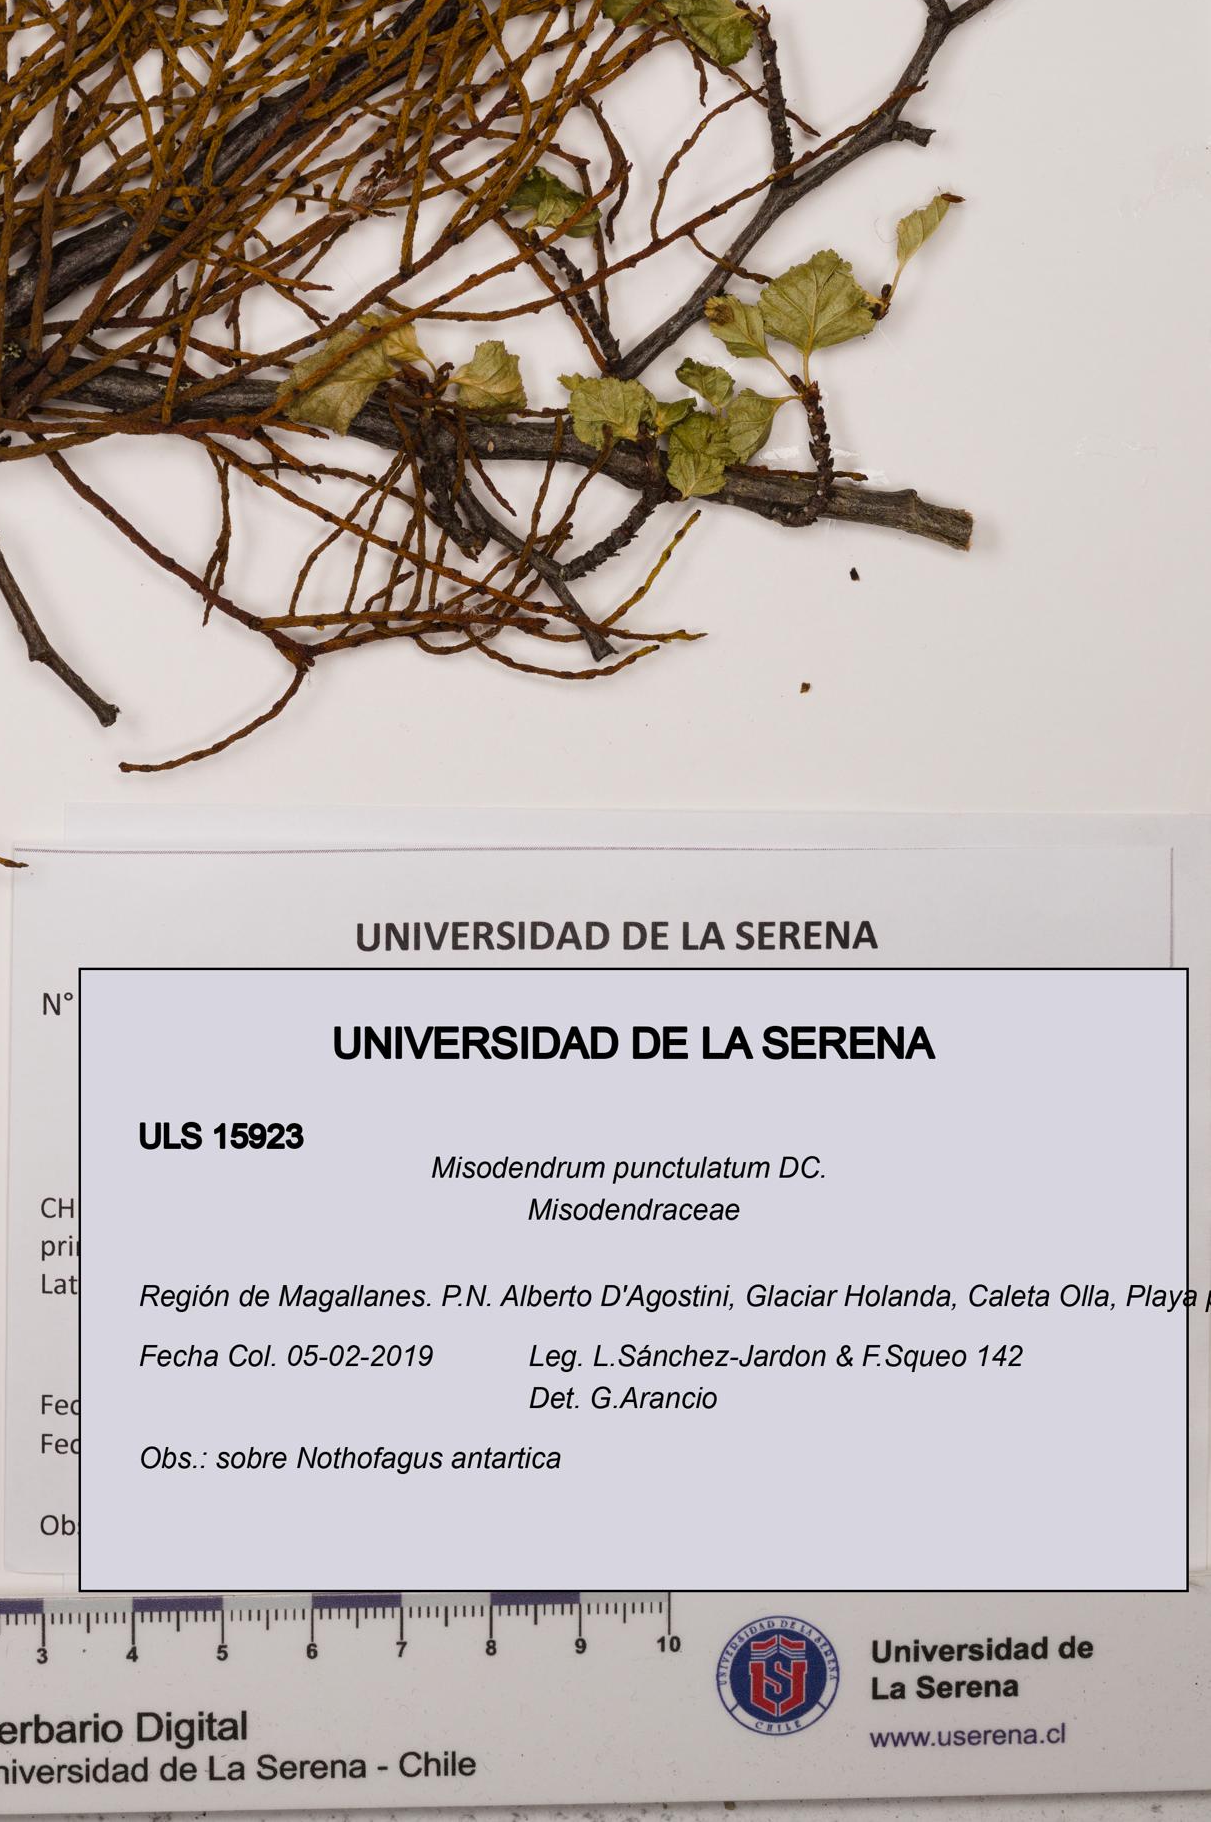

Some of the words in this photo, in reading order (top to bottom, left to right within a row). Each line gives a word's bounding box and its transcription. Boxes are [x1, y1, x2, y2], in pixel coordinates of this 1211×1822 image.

[356, 920, 610, 952] UNIVERSIDAD
[623, 921, 669, 951] DE
[682, 921, 726, 951] LA
[735, 920, 879, 951] SERENA
[42, 992, 74, 1016] N°
[40, 1235, 78, 1261] pri
[39, 1513, 80, 1537] Ob
[36, 1647, 49, 1665] 3
[125, 1645, 139, 1663] 4
[216, 1644, 229, 1662] 5
[306, 1642, 319, 1660] 6
[395, 1640, 408, 1658] 7
[485, 1638, 497, 1657] 8
[574, 1637, 588, 1655] 9
[656, 1635, 682, 1653] 10
[871, 1635, 1049, 1664] Universidad
[1057, 1635, 1094, 1660] de
[871, 1676, 906, 1701] La
[915, 1674, 1019, 1700] Serena
[136, 1710, 248, 1750] Digital
[869, 1722, 1066, 1748] www.userena.cl
[159, 1755, 198, 1783] de
[208, 1755, 246, 1782] La
[256, 1753, 367, 1781] Serena
[398, 1750, 477, 1778] Chile
